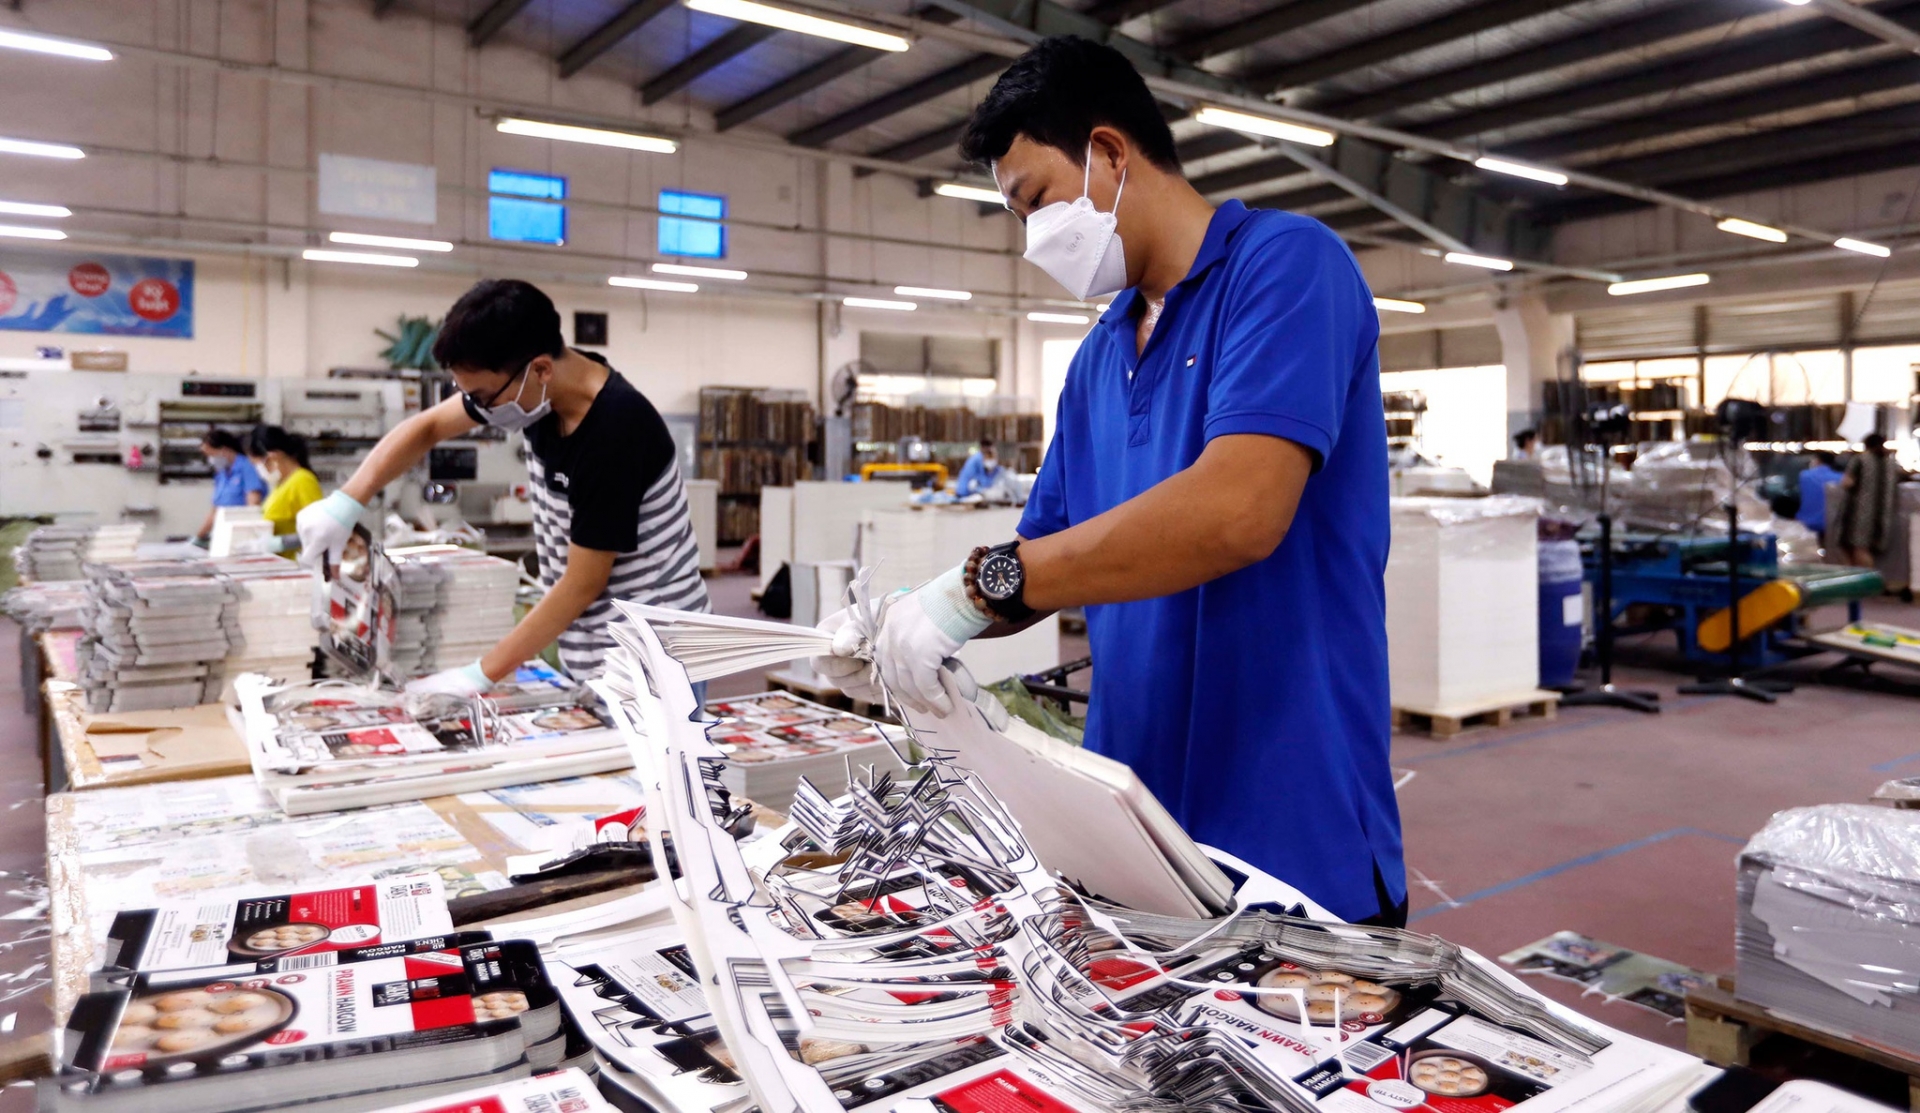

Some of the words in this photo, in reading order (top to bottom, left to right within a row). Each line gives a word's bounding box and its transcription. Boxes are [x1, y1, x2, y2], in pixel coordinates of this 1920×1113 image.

[357, 944, 406, 954] HARGOW
[367, 948, 406, 957] PRAWN
[336, 969, 355, 997] PRAWN
[417, 978, 439, 988] MR
[385, 982, 410, 1003] CHEN'S
[336, 996, 357, 1033] HARGOW
[1191, 1003, 1260, 1034] HARGOW
[1257, 1028, 1318, 1057] PRAWN
[1301, 1070, 1331, 1087] PRAWN
[555, 1086, 581, 1101] MR
[1374, 1089, 1388, 1097] TIP
[1388, 1093, 1413, 1105] TASTY
